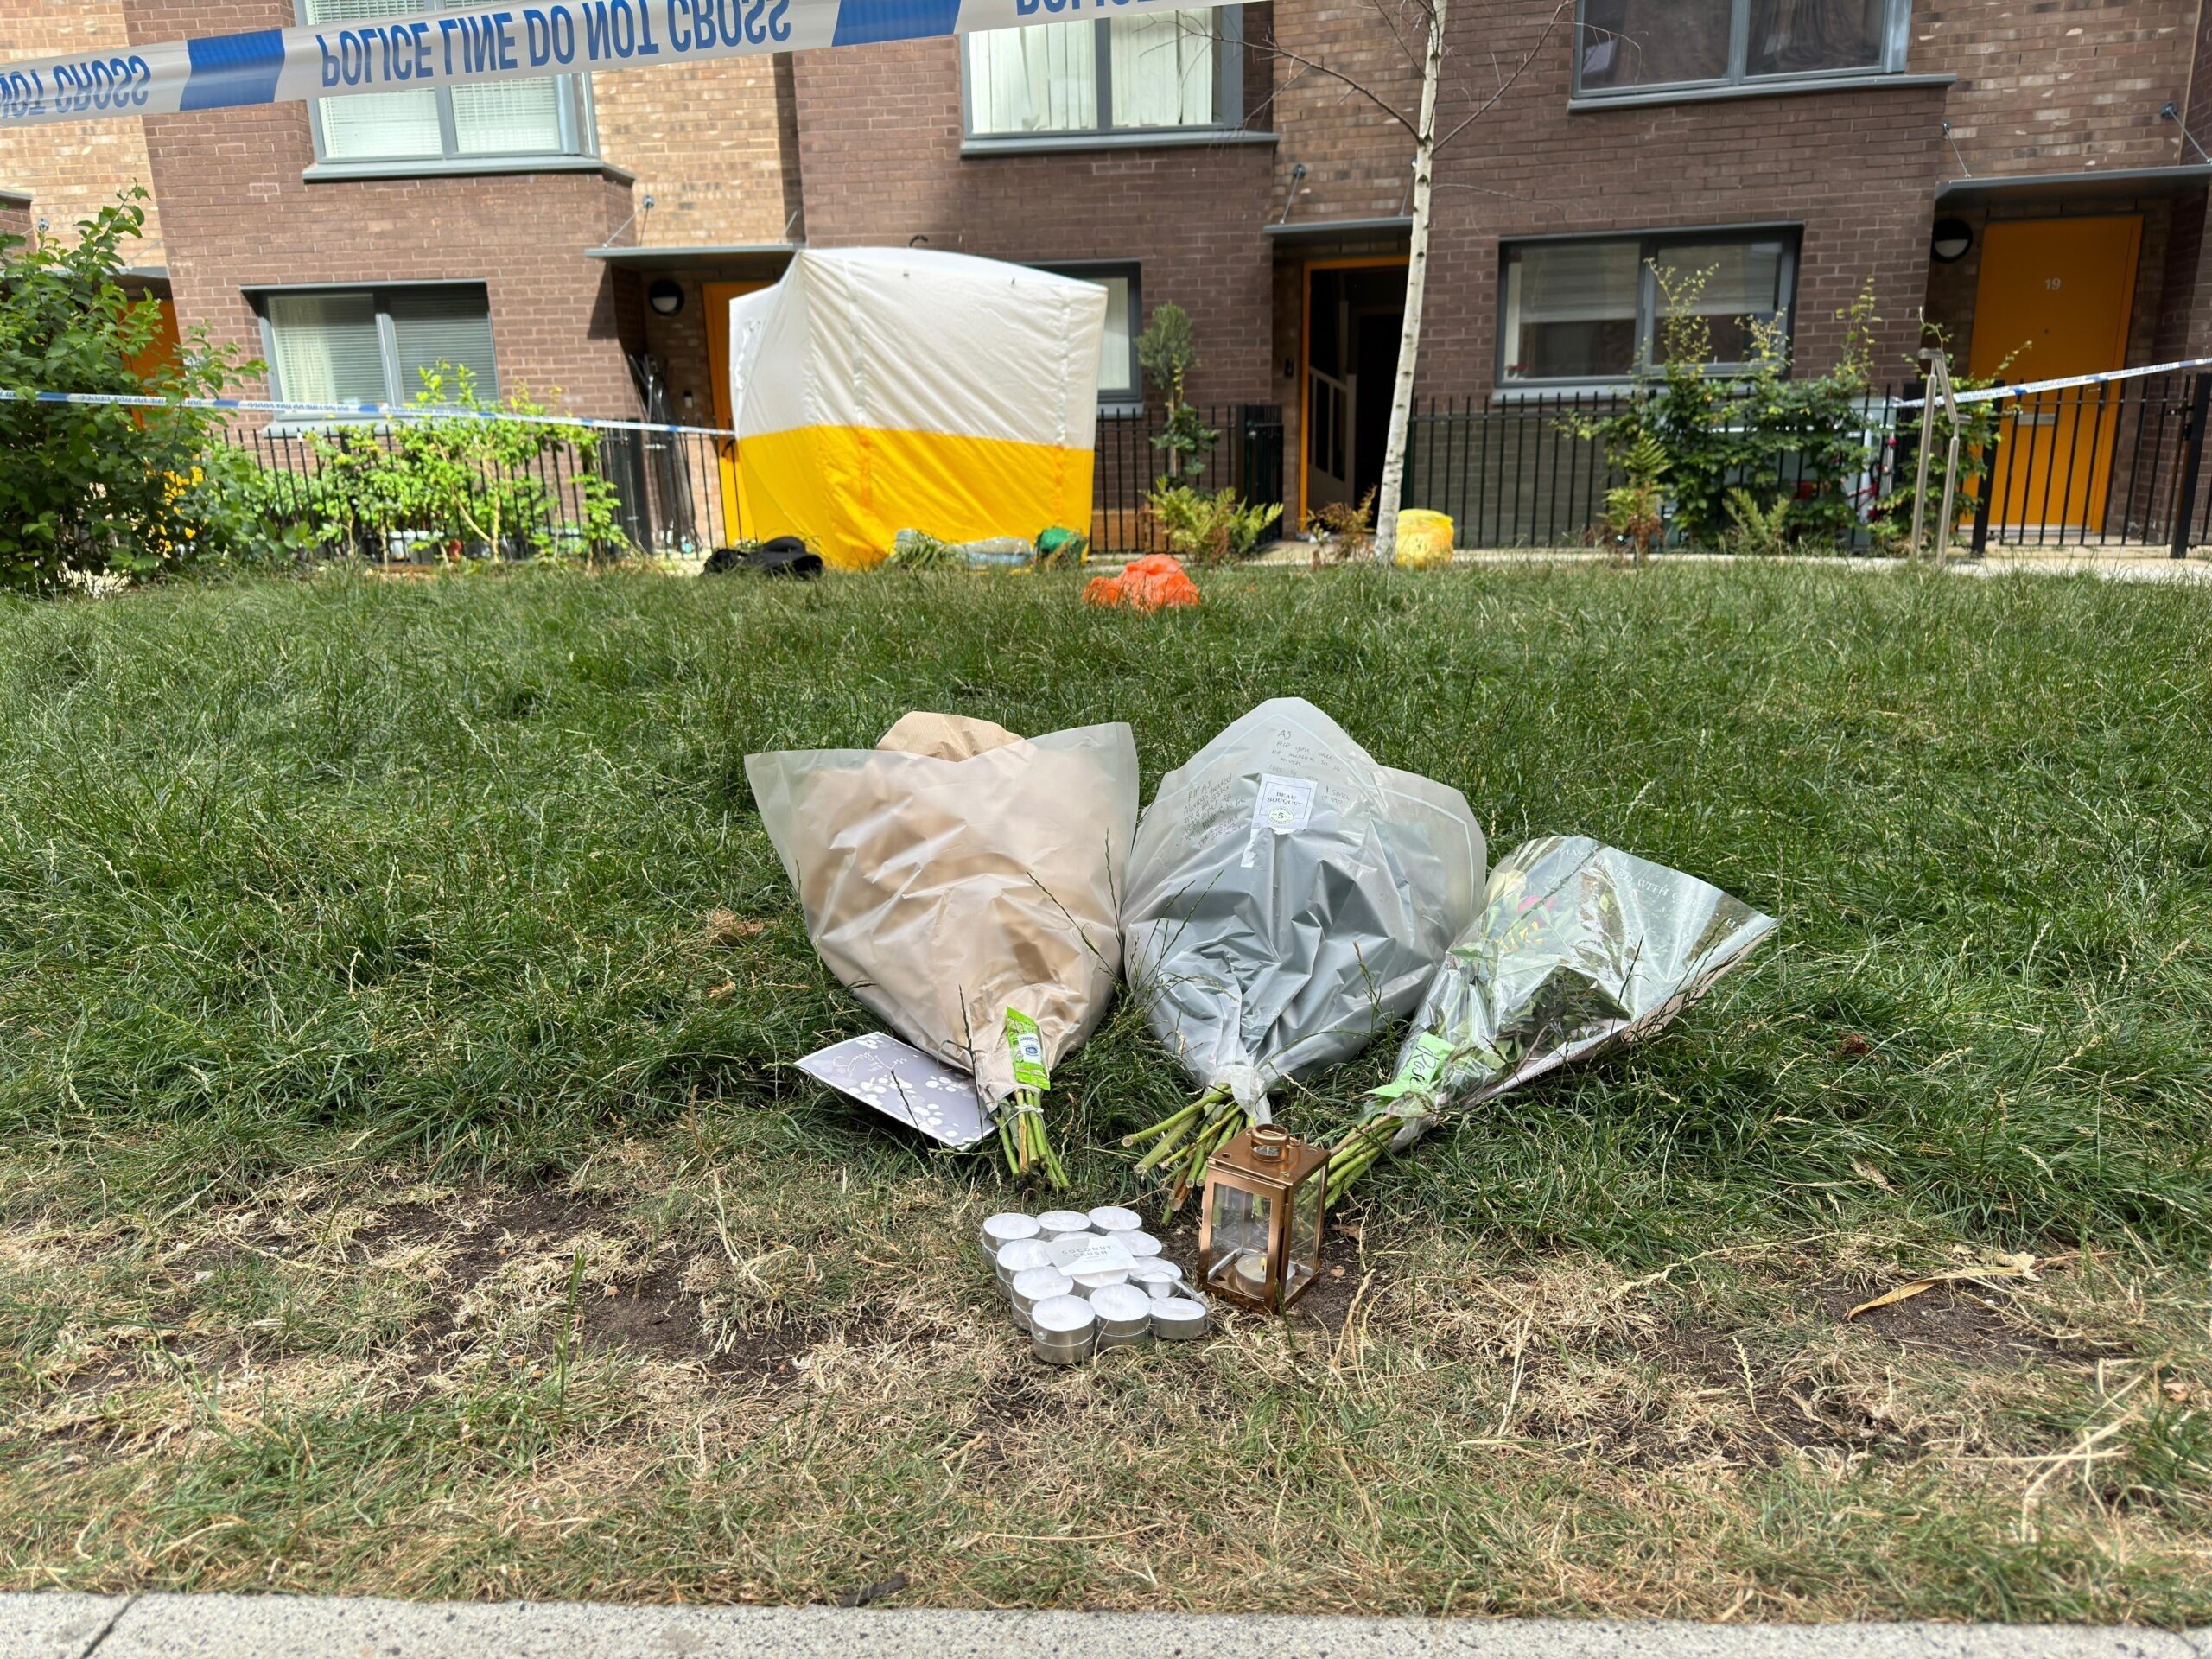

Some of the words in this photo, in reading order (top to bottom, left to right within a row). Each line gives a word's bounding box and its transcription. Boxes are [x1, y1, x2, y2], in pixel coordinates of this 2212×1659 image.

[2045, 277, 2061, 290] 19
[1275, 791, 1297, 800] BEAU
[1267, 797, 1302, 807] BOUQUET
[1637, 878, 1669, 897] WITH
[1061, 1245, 1112, 1255] COCONUT
